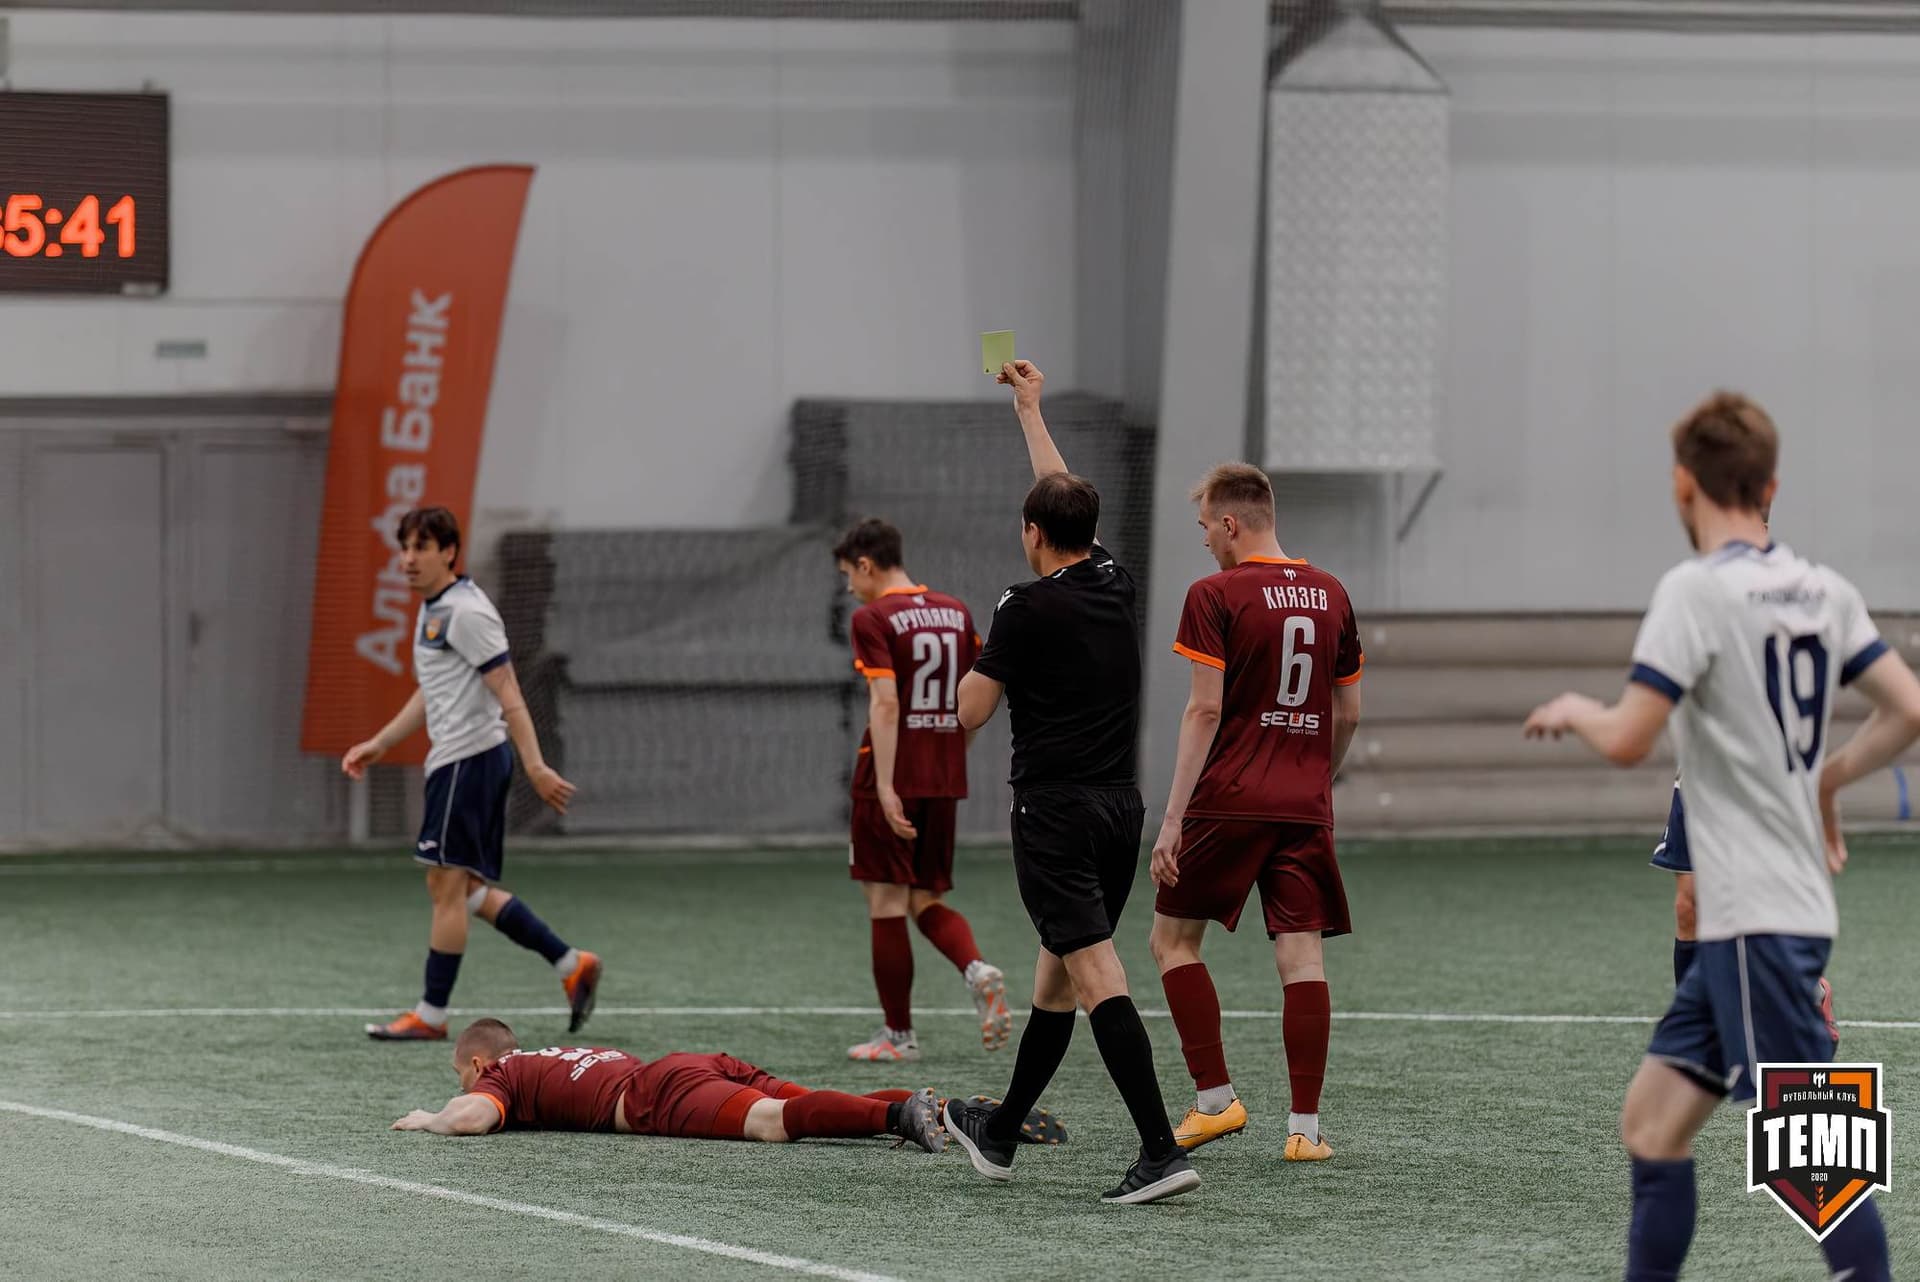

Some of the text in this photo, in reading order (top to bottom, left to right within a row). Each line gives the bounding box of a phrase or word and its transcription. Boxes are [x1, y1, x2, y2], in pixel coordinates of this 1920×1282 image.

[0, 193, 136, 258] 5:41
[381, 288, 453, 452] Банк
[1262, 586, 1328, 611] КНЯЗЕВ
[911, 632, 958, 710] 21
[1276, 615, 1316, 707] 6
[906, 713, 958, 729] SEUS
[1260, 710, 1320, 729] SEUS
[1764, 633, 1829, 773] 19
